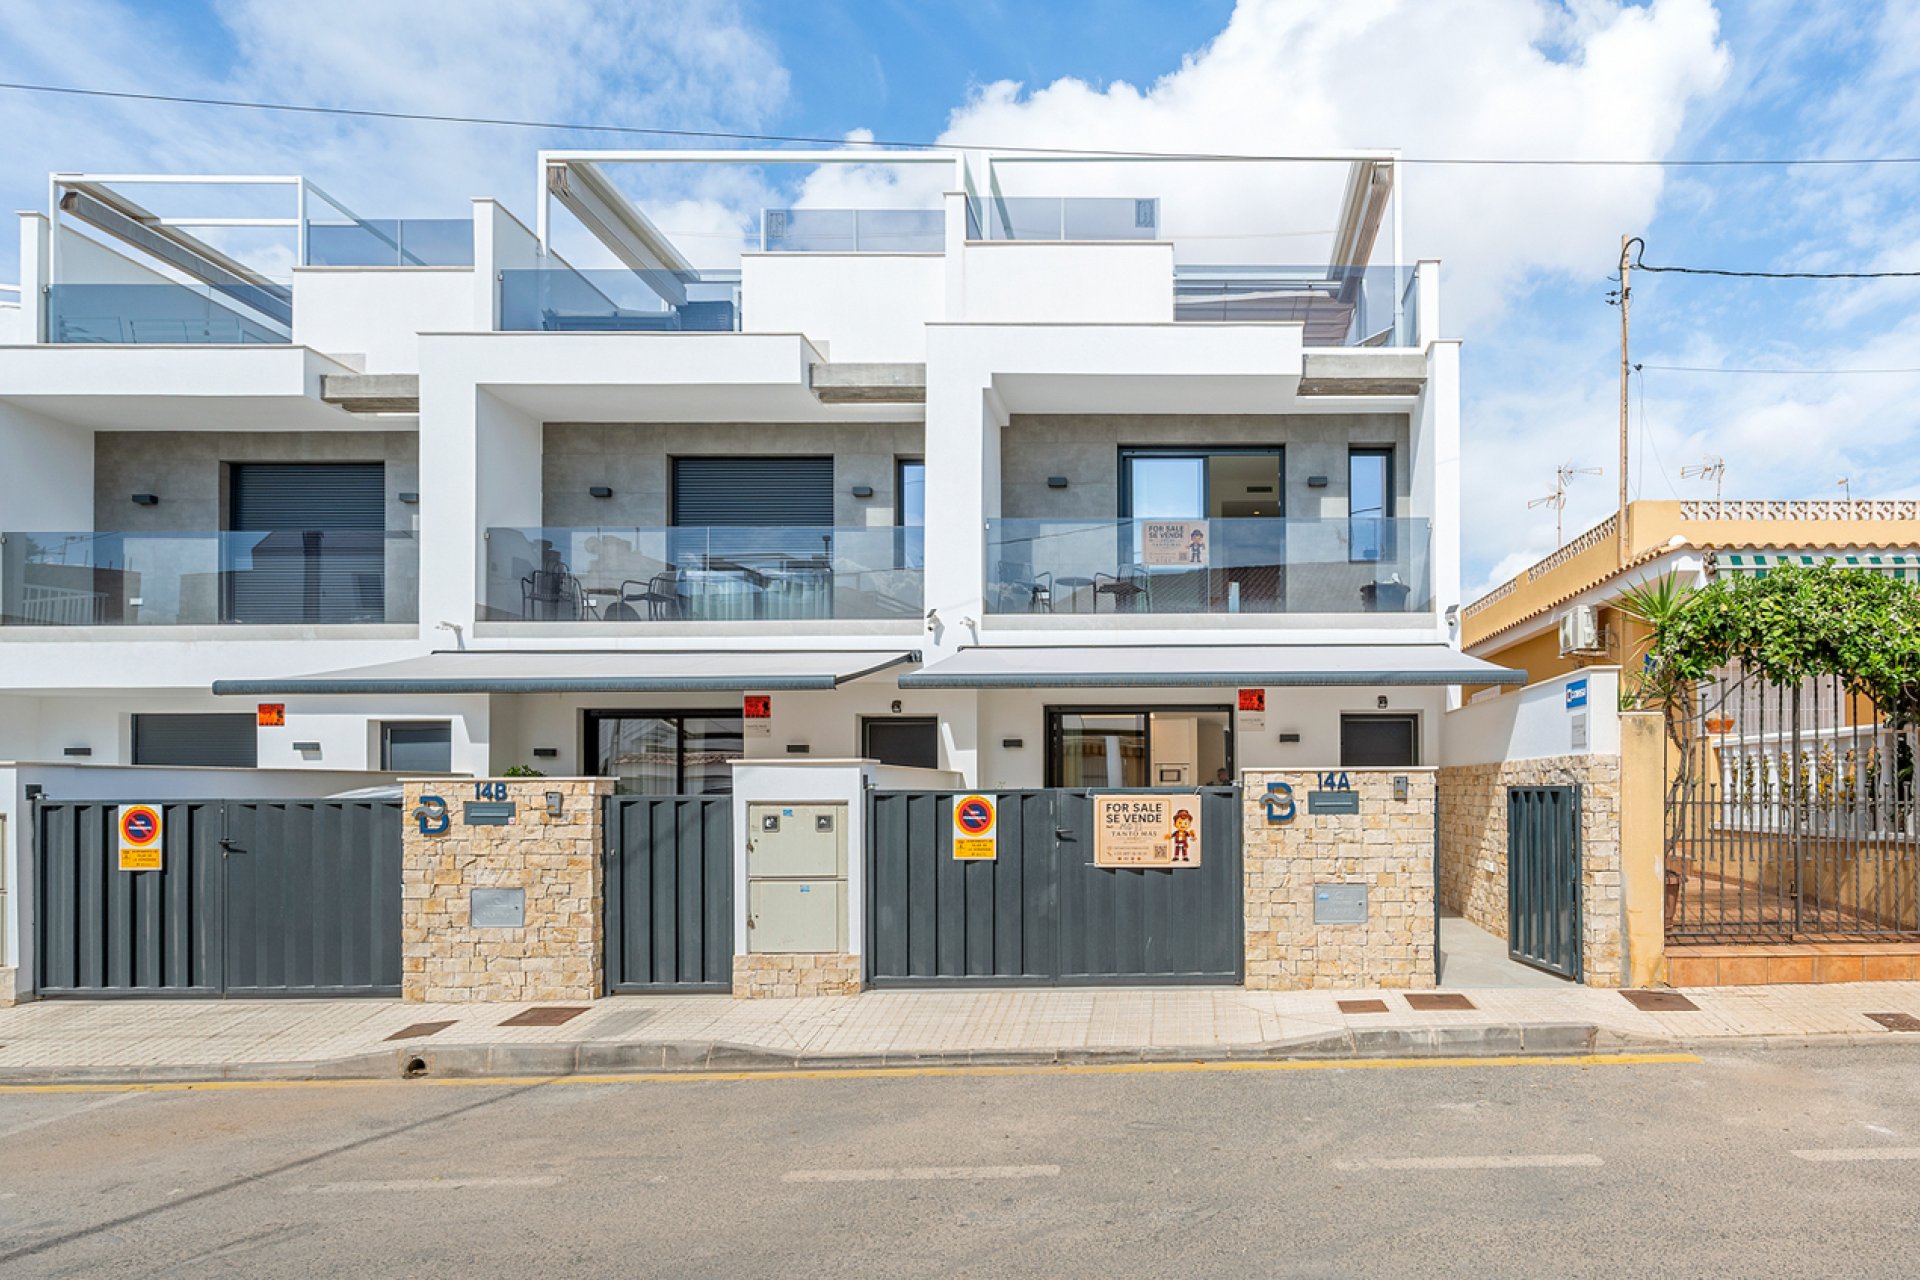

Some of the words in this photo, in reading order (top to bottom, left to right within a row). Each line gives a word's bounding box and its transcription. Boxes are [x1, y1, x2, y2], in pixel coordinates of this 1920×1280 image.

[1148, 531, 1158, 539] SE
[1160, 531, 1184, 539] VENDE
[1317, 771, 1351, 793] 14A
[475, 782, 508, 801] 14B
[1106, 803, 1129, 812] FOR
[1133, 803, 1162, 812] SALE
[1106, 814, 1120, 823] SE
[1123, 814, 1162, 823] VENDE
